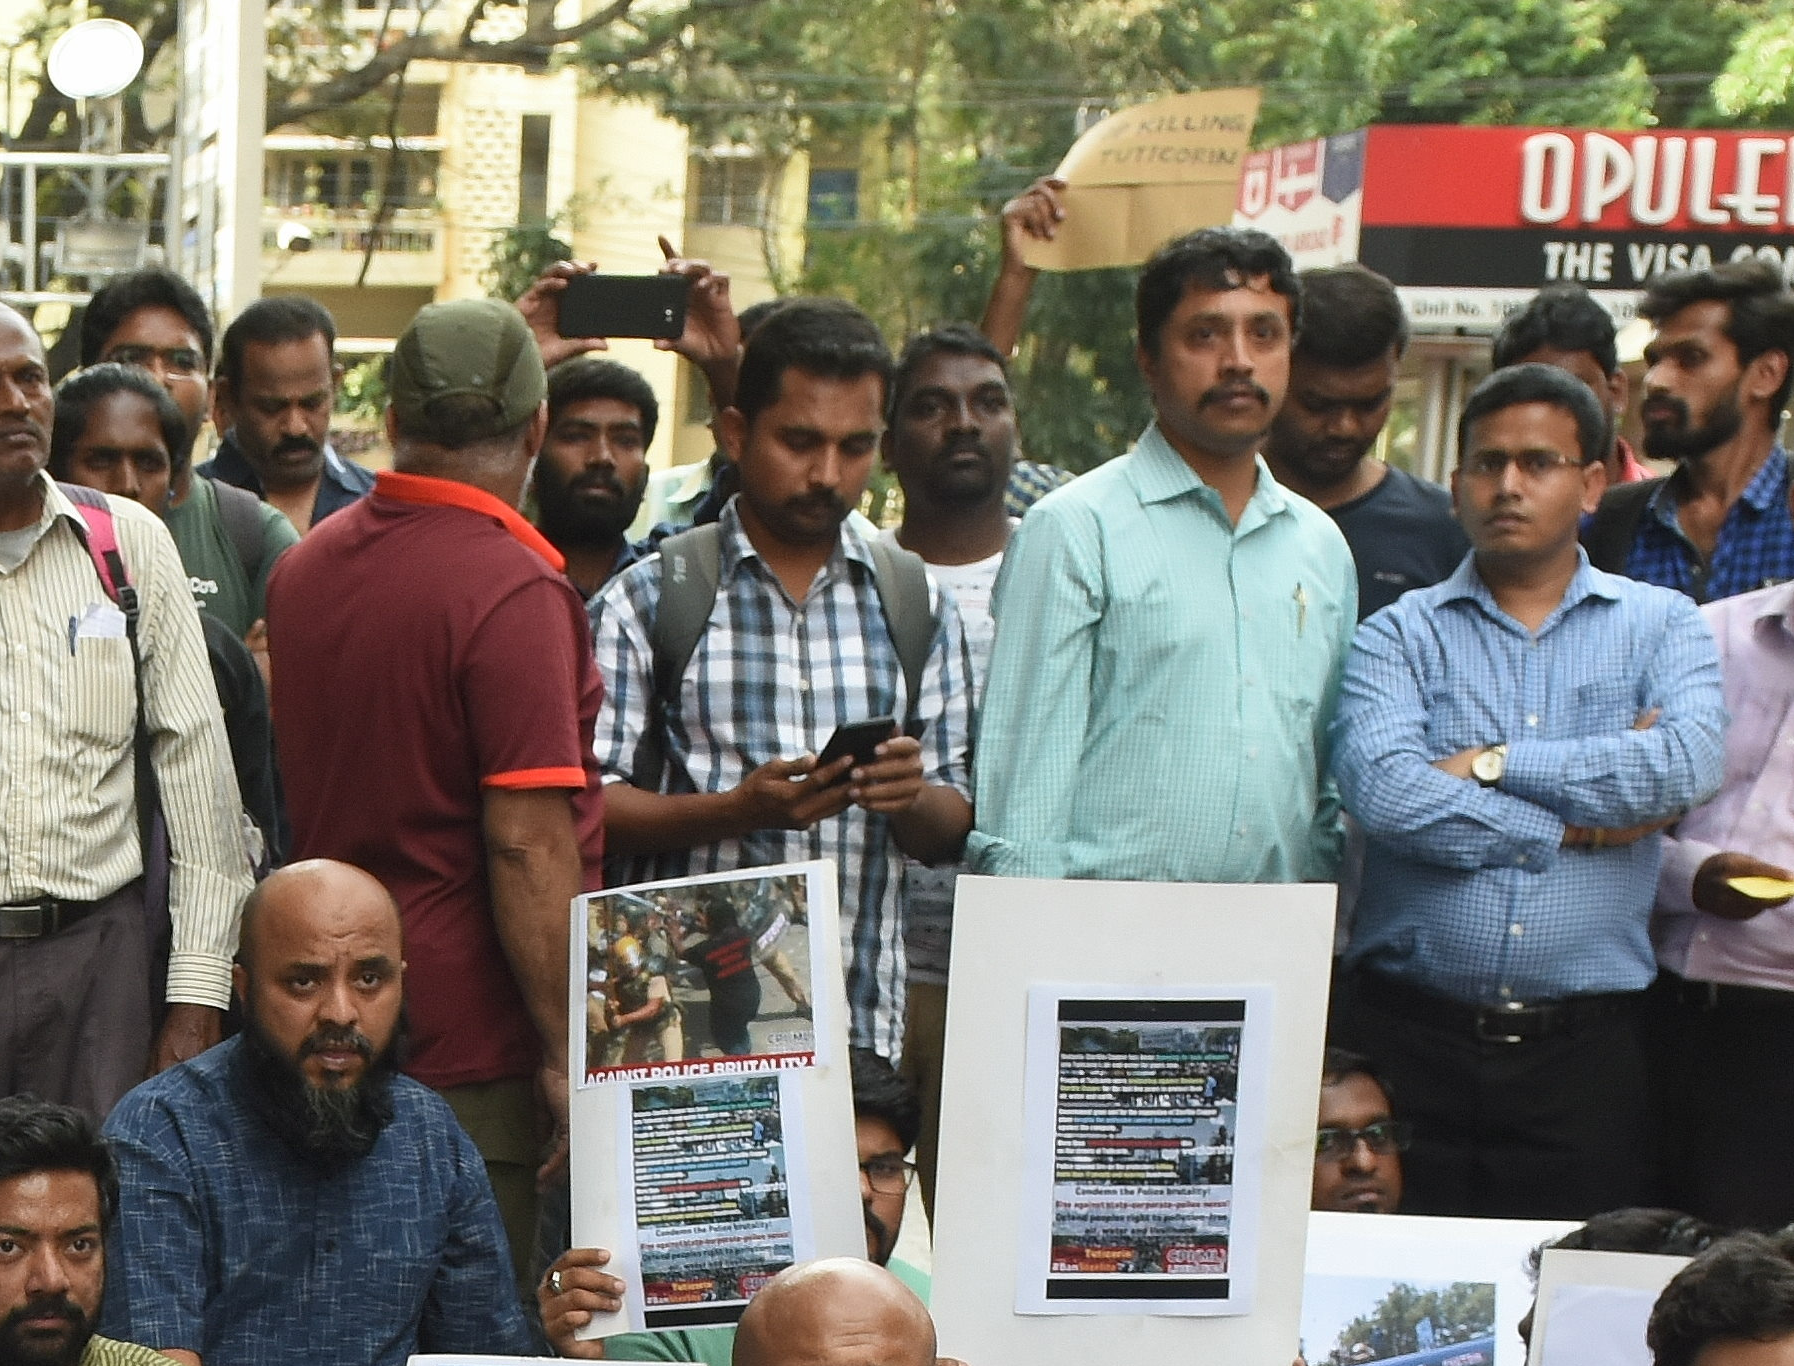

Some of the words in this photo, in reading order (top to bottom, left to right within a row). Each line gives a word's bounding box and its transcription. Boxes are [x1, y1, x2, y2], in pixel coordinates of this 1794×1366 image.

[1138, 113, 1244, 135] KILLING
[1100, 144, 1237, 167] TUTICORIN
[1542, 242, 1615, 283] THE
[1627, 242, 1712, 282] VISA
